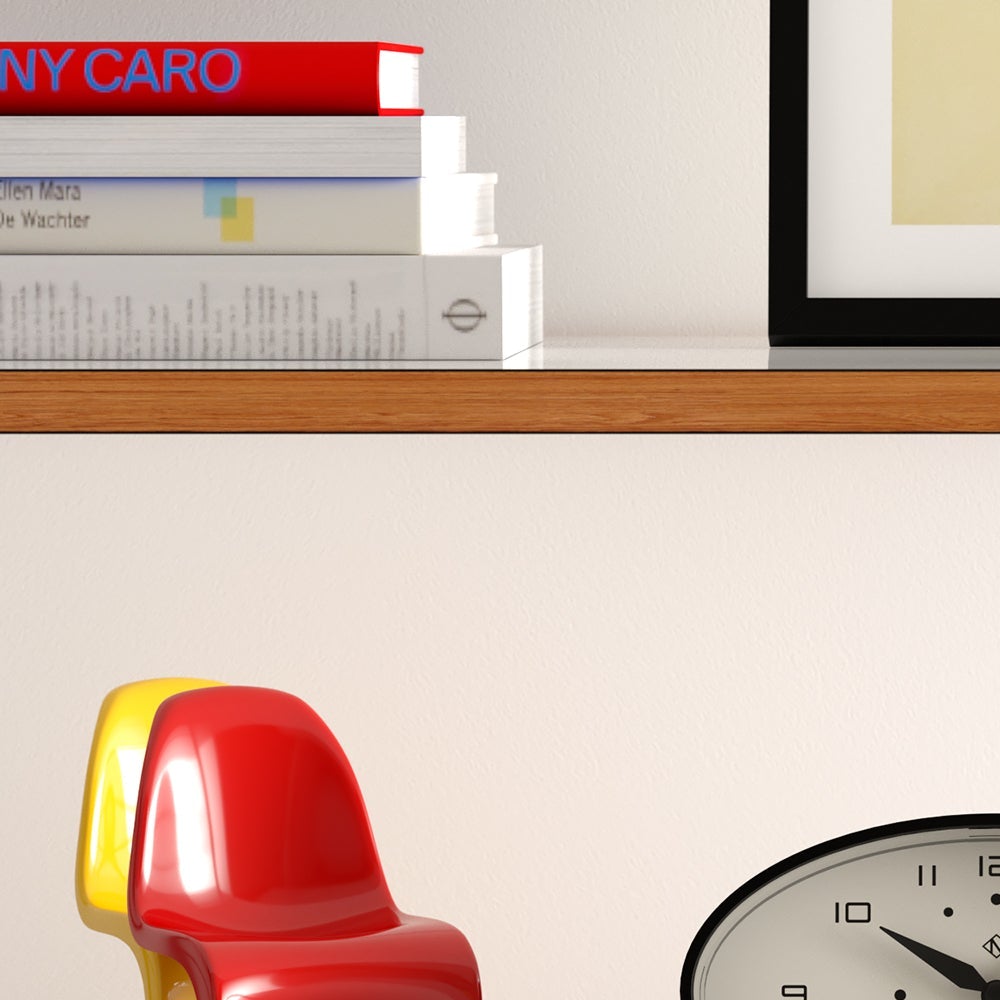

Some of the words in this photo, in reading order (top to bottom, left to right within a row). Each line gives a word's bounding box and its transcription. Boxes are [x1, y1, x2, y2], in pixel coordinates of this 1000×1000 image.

[0, 49, 76, 92] NY
[84, 48, 241, 93] CARO
[39, 181, 81, 201] Mara
[21, 209, 91, 229] Wachter
[918, 865, 936, 886] 11
[835, 902, 871, 923] 10
